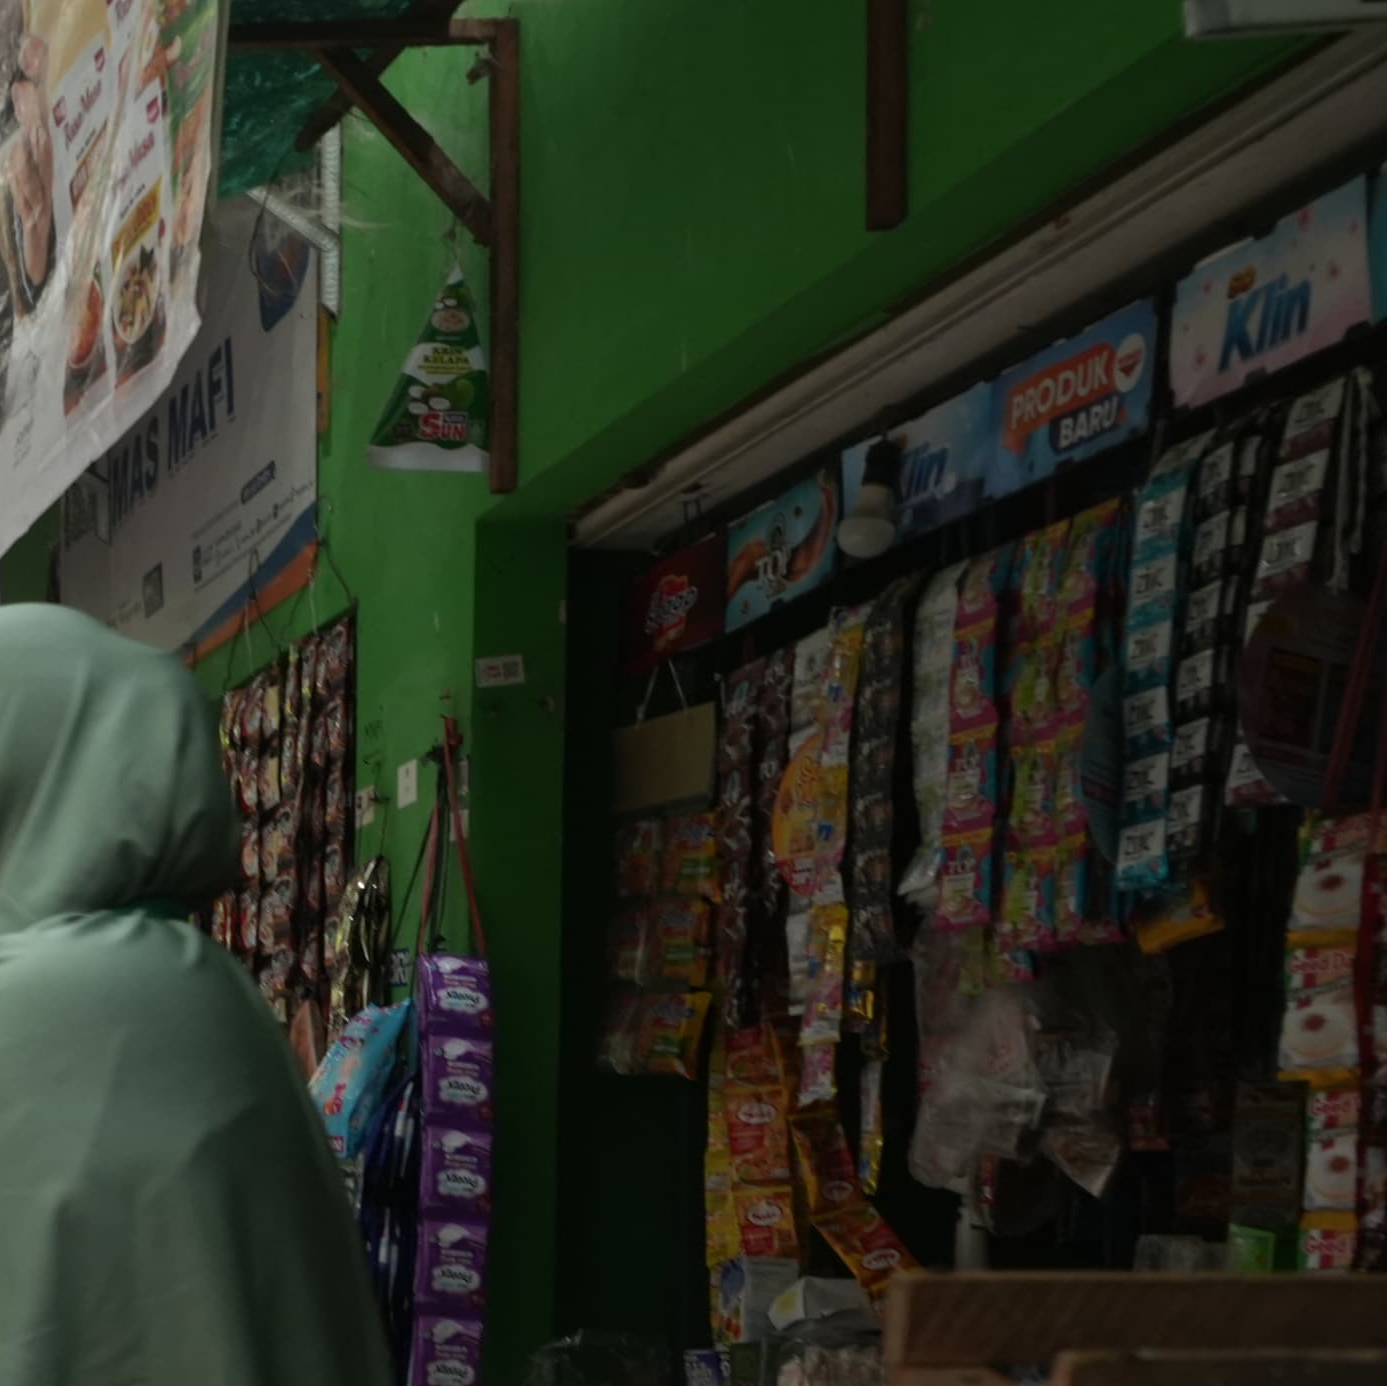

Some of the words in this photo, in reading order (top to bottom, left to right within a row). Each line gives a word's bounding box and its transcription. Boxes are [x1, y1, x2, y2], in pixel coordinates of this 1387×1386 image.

[1219, 274, 1311, 372] Klin
[1010, 352, 1109, 428] PRODUK
[1058, 397, 1118, 450] BARU
[113, 415, 159, 527] MAS
[167, 337, 234, 472] MAFI
[904, 448, 948, 499] lin
